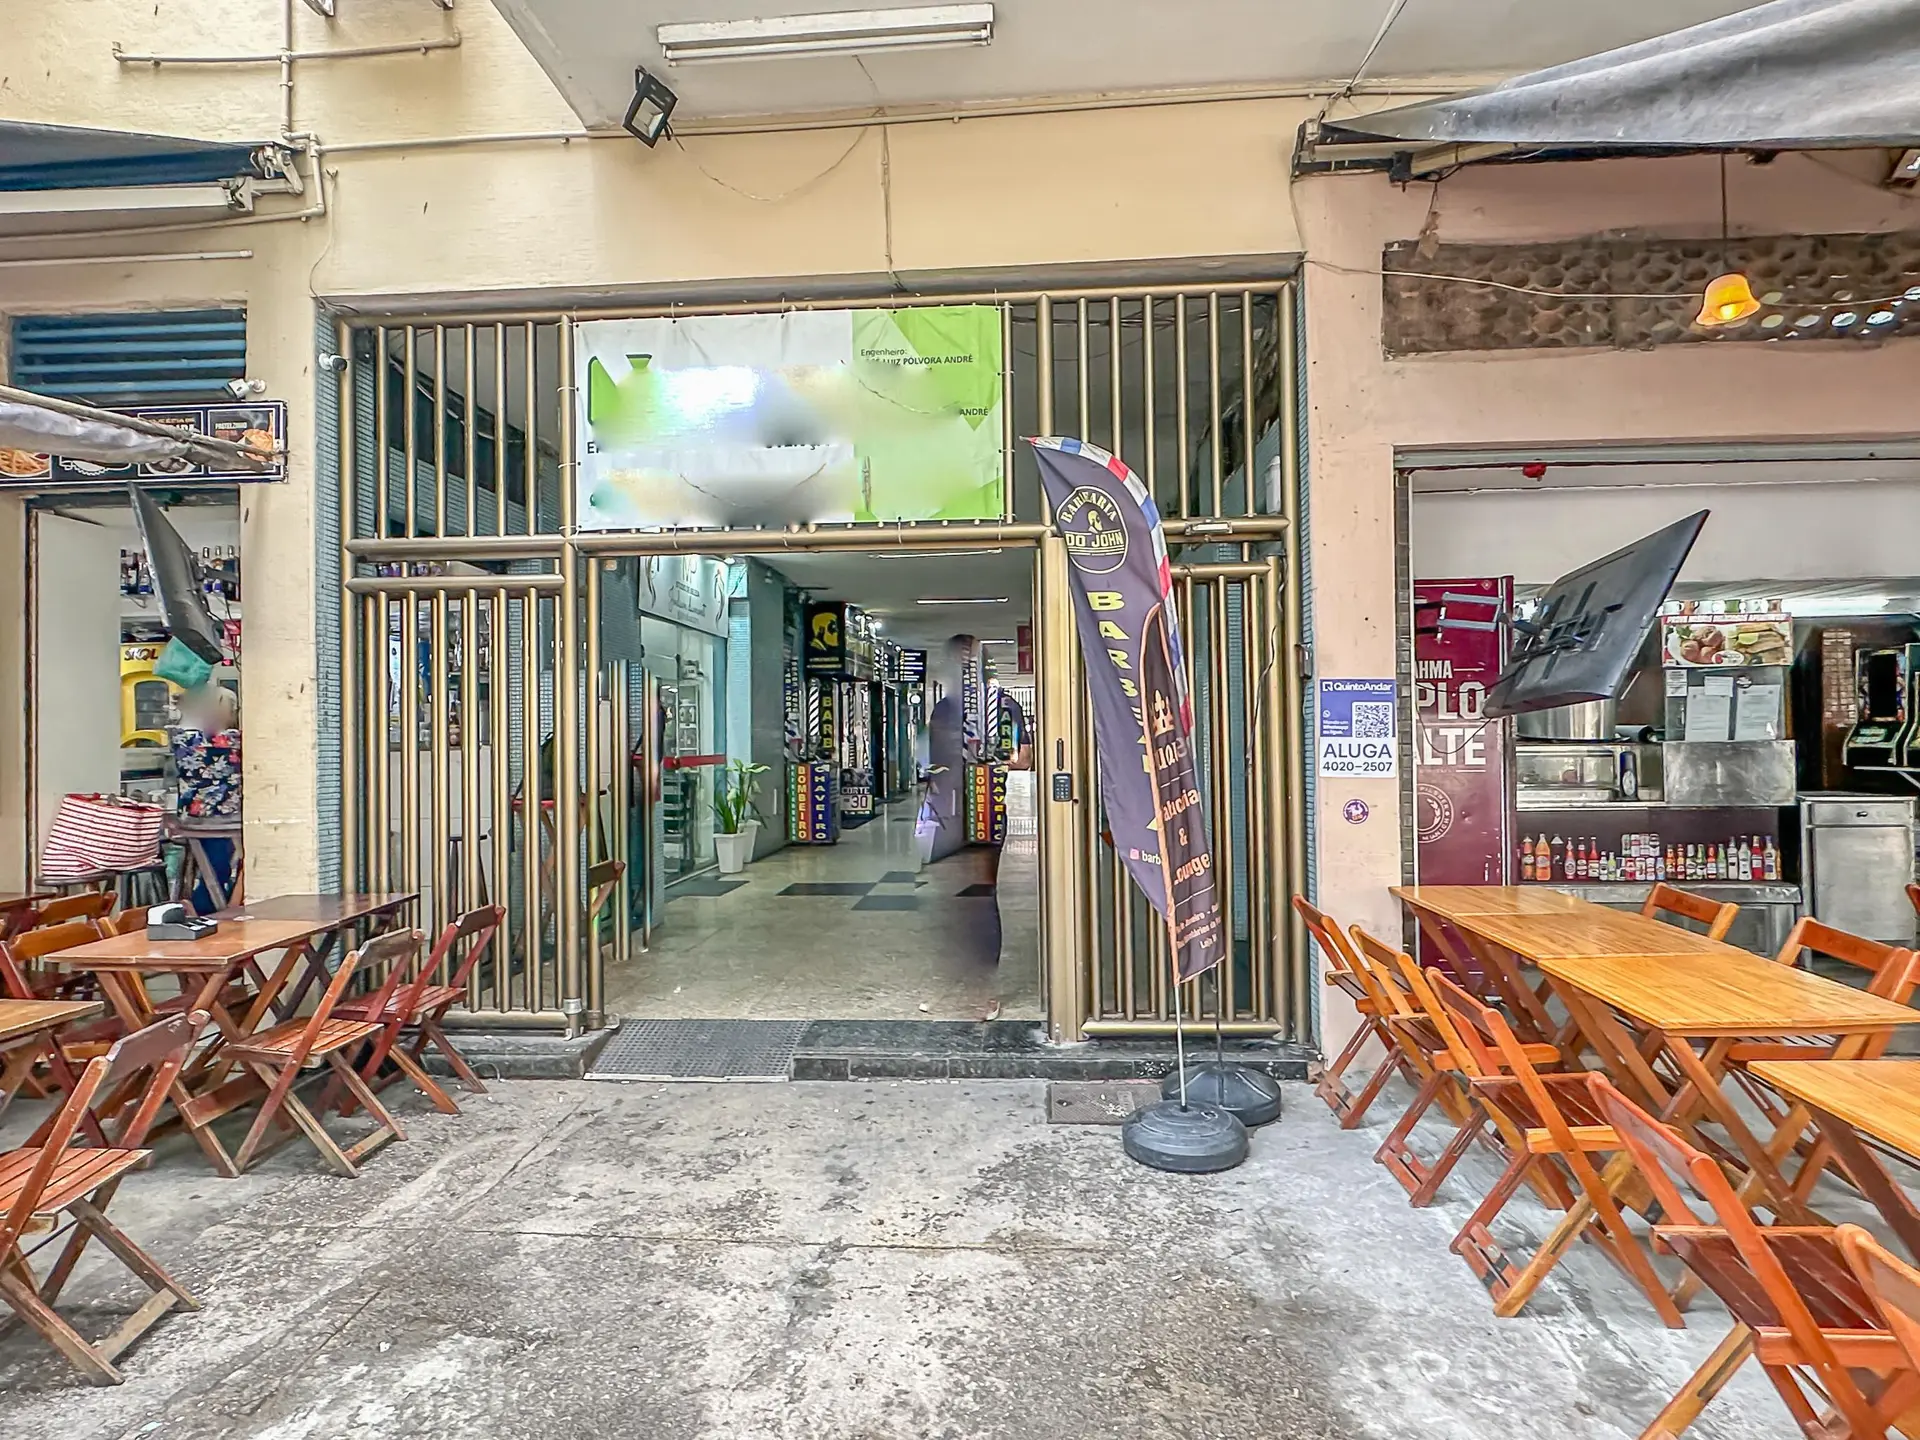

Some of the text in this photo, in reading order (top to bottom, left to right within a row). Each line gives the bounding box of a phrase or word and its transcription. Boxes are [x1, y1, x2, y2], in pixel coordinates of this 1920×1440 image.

[860, 348, 908, 357] Engenheiro:
[903, 356, 942, 365] PÓLVORA
[944, 354, 973, 364] ANDRÉ
[960, 406, 988, 416] ANDRÉ
[1065, 531, 1124, 548] DO JOHN
[124, 648, 159, 661] SKOL
[1333, 682, 1393, 691] QuintoAndar
[1323, 743, 1392, 759] ALUGA
[1323, 761, 1393, 772] 4020-2507
[841, 786, 870, 795] CORTE
[797, 766, 807, 840] BOMBEIRO
[814, 766, 827, 840] CHAVEIRO
[851, 795, 868, 808] 30
[976, 766, 985, 840] BOMBEIRO
[1178, 827, 1188, 846] &
